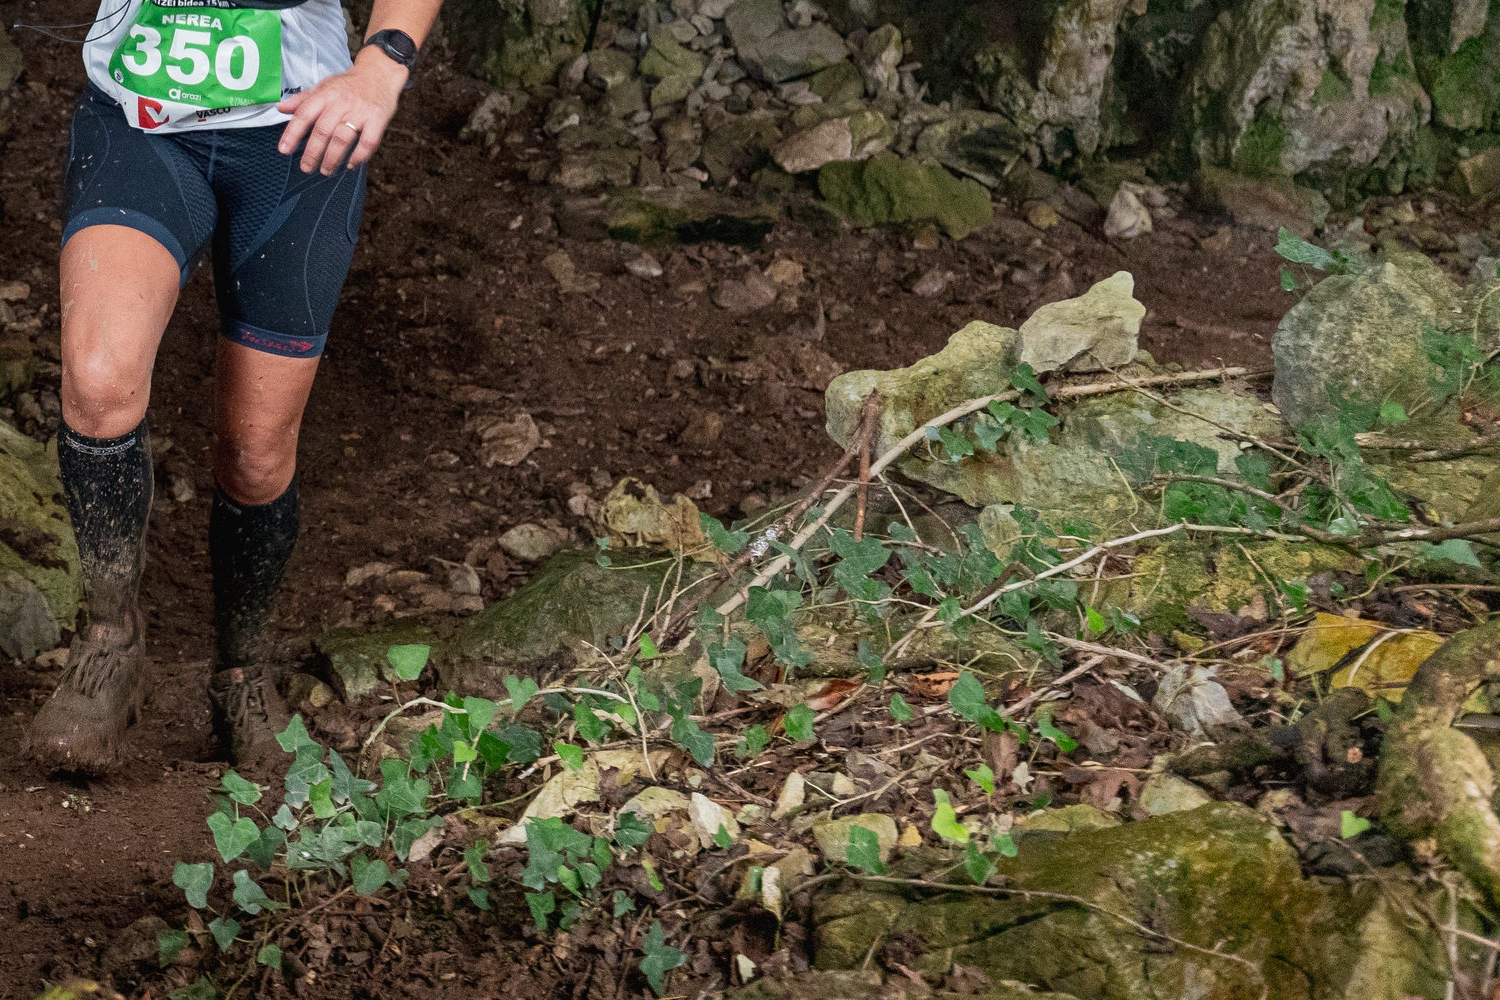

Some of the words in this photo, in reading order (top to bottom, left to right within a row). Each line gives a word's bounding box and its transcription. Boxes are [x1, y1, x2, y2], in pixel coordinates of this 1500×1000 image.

[177, 0, 204, 7] bidea
[161, 13, 223, 31] NEREA
[121, 23, 260, 91] 350
[195, 106, 232, 118] VASCO
